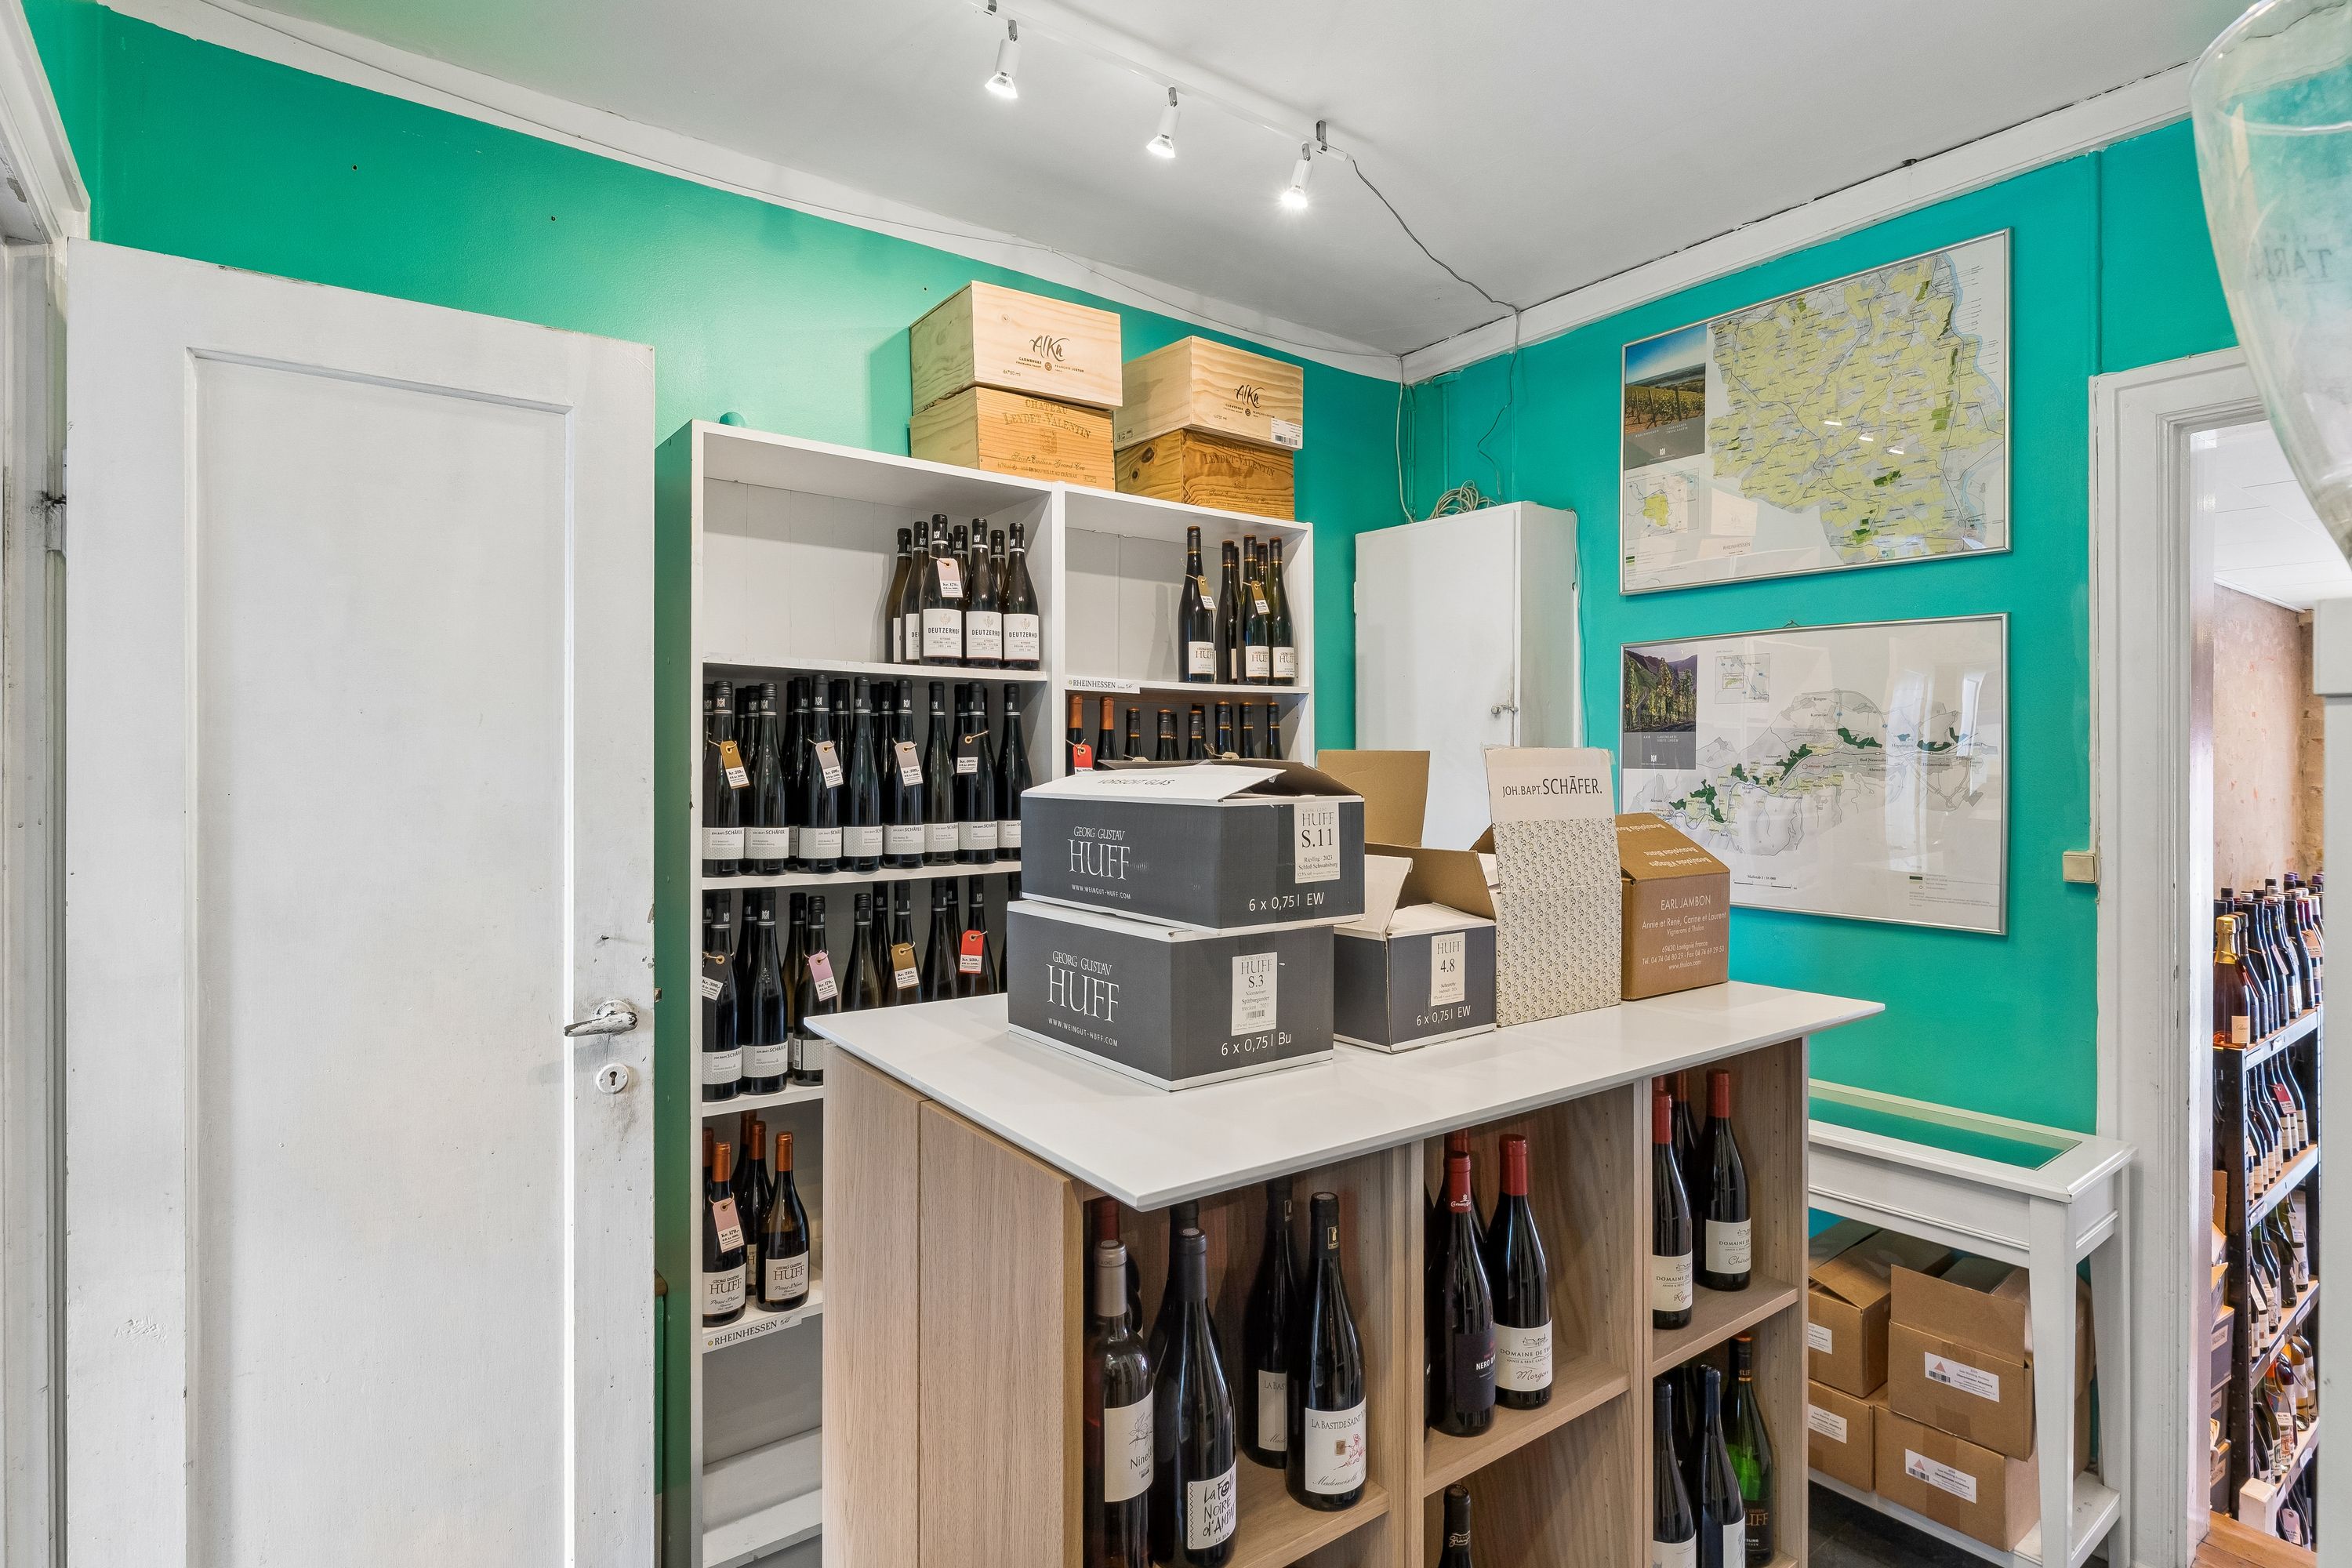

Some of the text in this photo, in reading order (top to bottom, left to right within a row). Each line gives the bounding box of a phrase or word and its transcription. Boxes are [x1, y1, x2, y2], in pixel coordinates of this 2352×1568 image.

[1073, 680, 1116, 688] RHEINHESSEN
[1302, 812, 1334, 826] HUFF
[1073, 826, 1125, 840] GEORG GUSTAV
[1301, 828, 1333, 848] S.11
[1068, 838, 1130, 880] HUFF
[1071, 884, 1131, 900] WWW.WEINGUT-HUFF.COM
[1249, 898, 1256, 912] 6
[1260, 900, 1267, 910] x
[1307, 892, 1324, 906] EW
[1661, 895, 1711, 910] EARL JAMBON
[1642, 920, 1659, 930] Annie
[1683, 915, 1701, 924] Carine
[1708, 912, 1726, 921] Laurent
[1666, 927, 1687, 937] Vignerons
[1437, 940, 1461, 955] HUFF
[1052, 950, 1112, 976] GEORG GUSTAV
[1241, 959, 1272, 975] HUFF
[1440, 958, 1455, 973] 4.8
[1668, 960, 1701, 970] www.thulon.com
[1248, 975, 1264, 988] S.3
[1046, 964, 1120, 1023] HUFF
[1416, 1014, 1422, 1026] 6
[1424, 1015, 1429, 1025] x
[1457, 1005, 1471, 1018] EW
[1048, 1018, 1118, 1047] WWW.WEINGUT-HUFF.COM
[1221, 1043, 1229, 1056] 6
[1232, 1044, 1240, 1054] x
[1278, 1032, 1291, 1046] Bu
[773, 1265, 805, 1281] HUFF
[709, 1278, 742, 1295] HUFF
[714, 1319, 777, 1346] RHEINHESSEN
[1500, 1348, 1534, 1357] DOMAINE
[1476, 1359, 1490, 1370] NERO
[1515, 1370, 1548, 1382] Morgon
[1265, 1380, 1272, 1389] LA
[1312, 1415, 1363, 1430] LA BASTIDE SAINT
[1204, 1486, 1216, 1504] La
[1745, 1512, 1769, 1526] UFF
